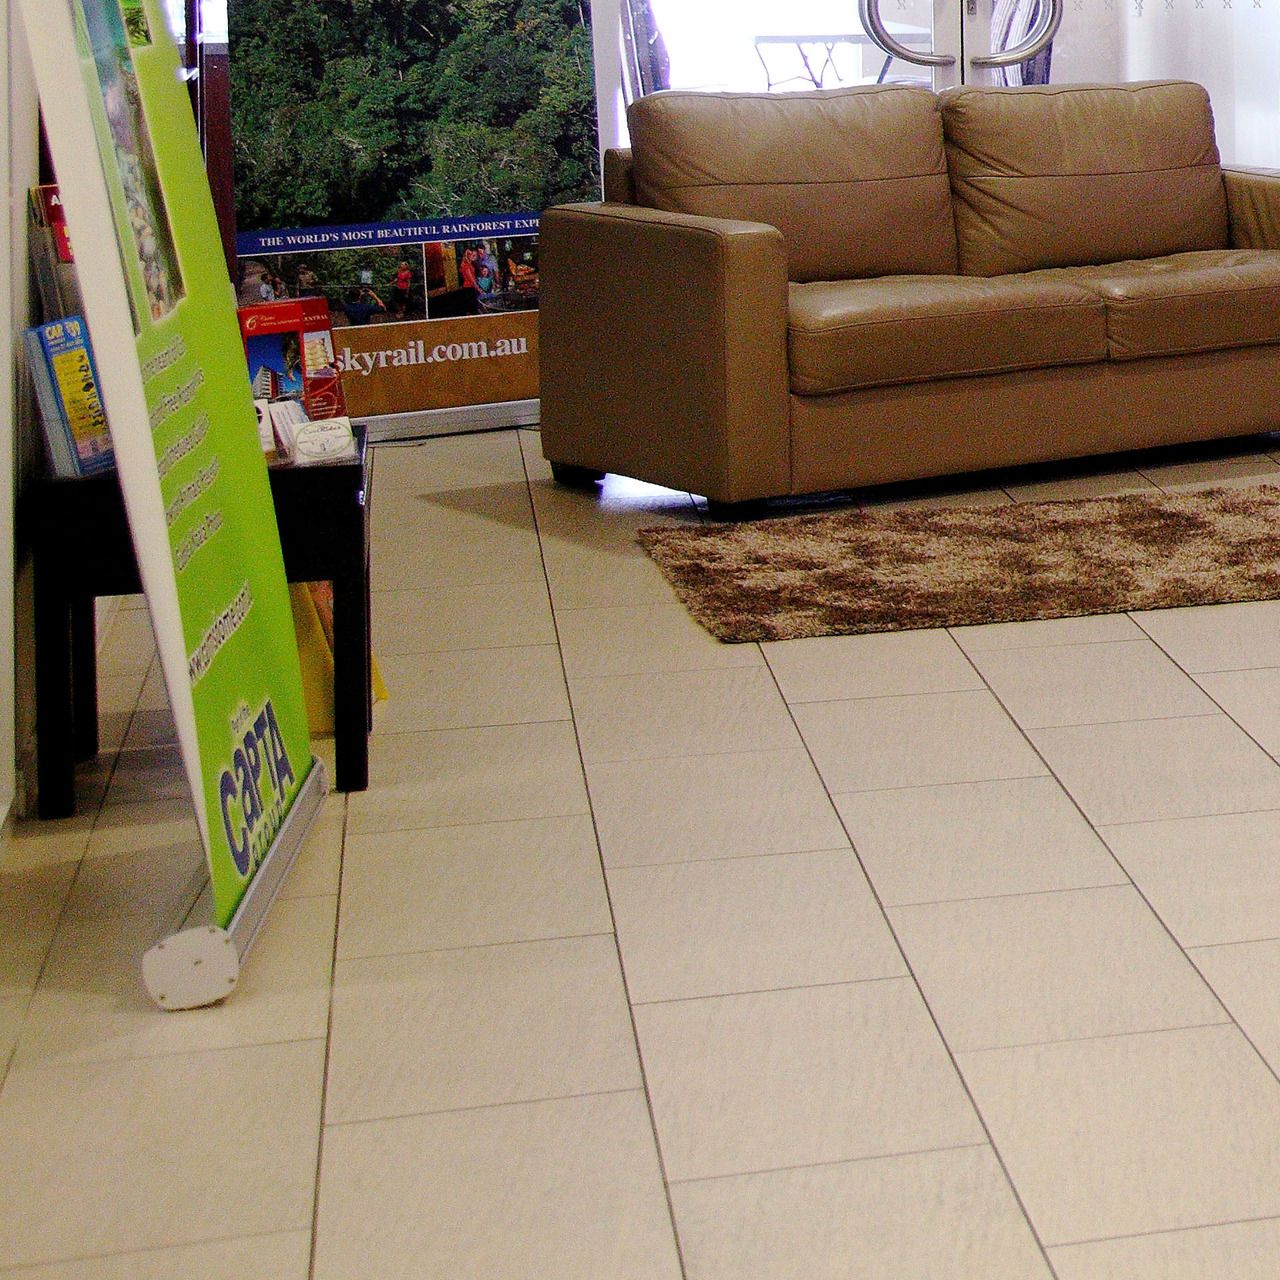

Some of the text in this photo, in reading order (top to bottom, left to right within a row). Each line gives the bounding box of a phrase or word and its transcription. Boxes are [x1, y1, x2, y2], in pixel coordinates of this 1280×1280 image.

[259, 236, 284, 247] THE
[286, 232, 340, 246] WORLD'S
[342, 230, 374, 242] MOST
[376, 225, 440, 239] BEAUTIFUL
[441, 220, 512, 236] RAINFOREST
[334, 336, 529, 377] skyrail.com.au
